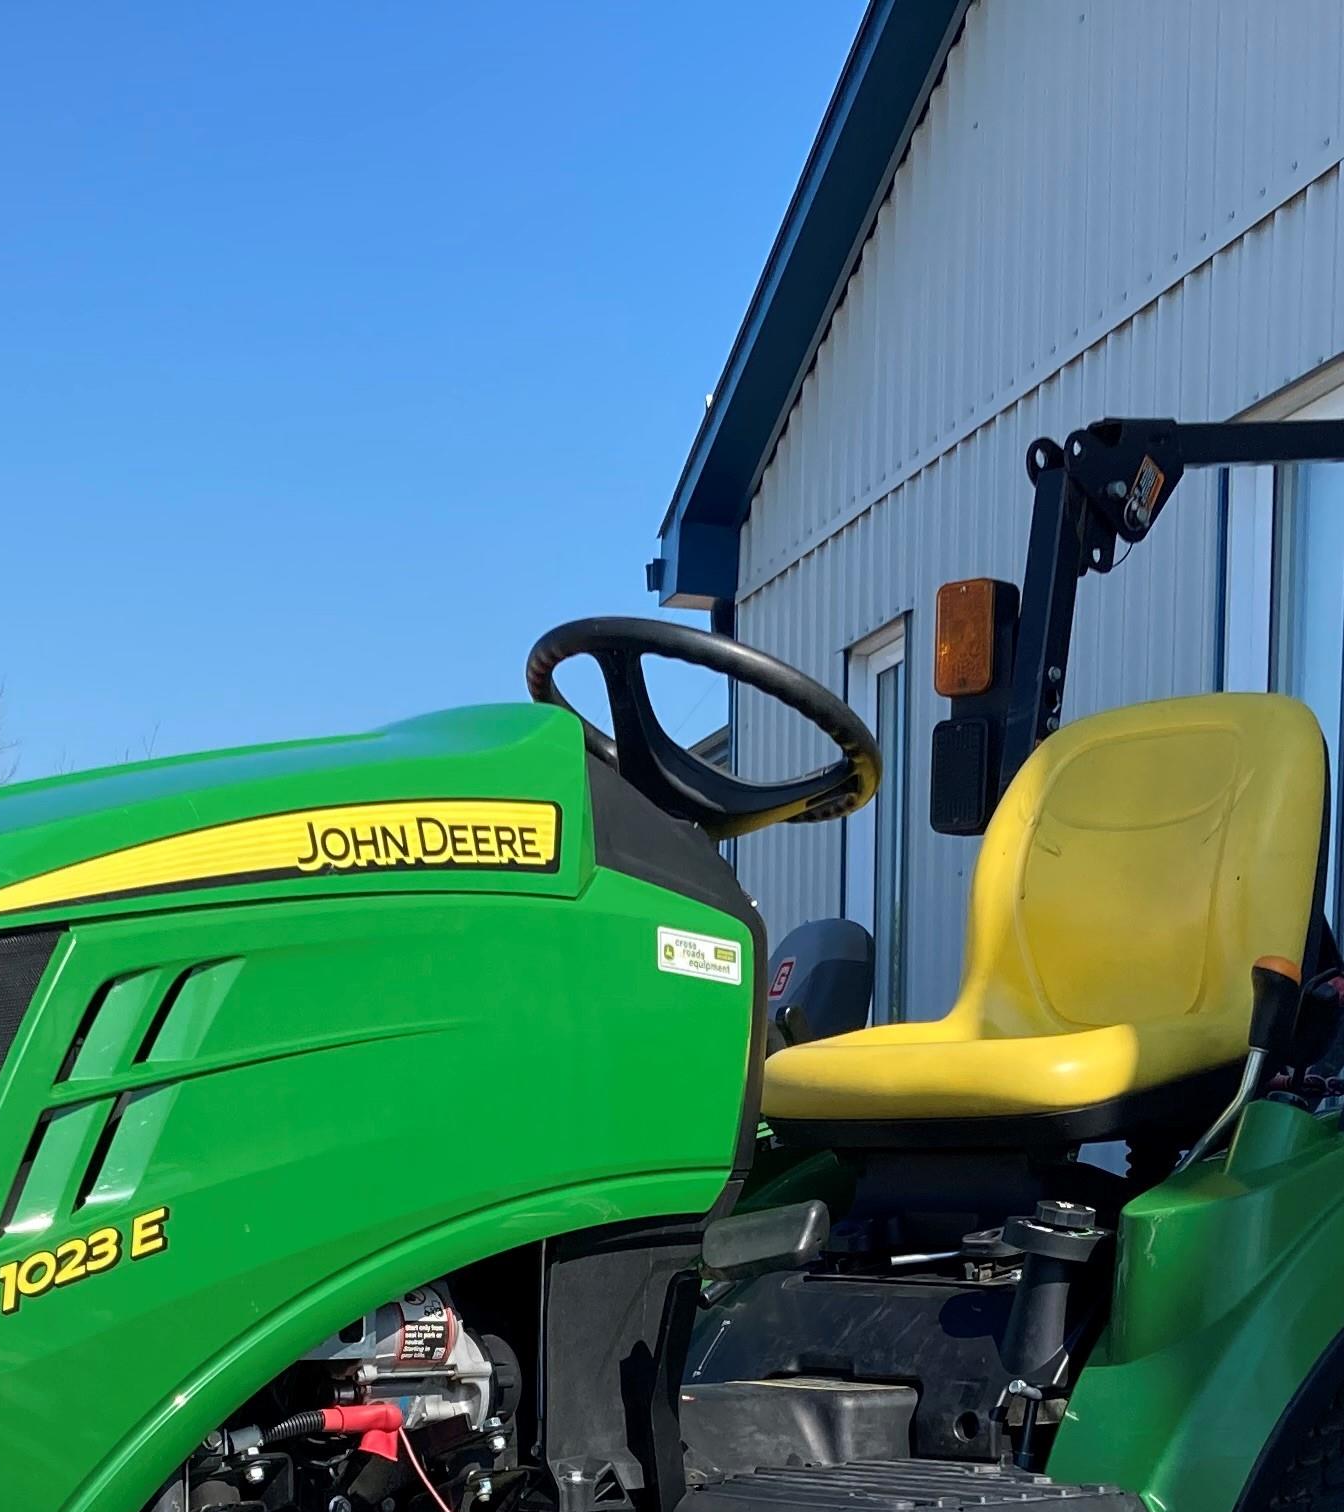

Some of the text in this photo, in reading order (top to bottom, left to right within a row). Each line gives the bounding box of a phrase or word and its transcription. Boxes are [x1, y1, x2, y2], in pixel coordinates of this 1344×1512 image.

[297, 817, 542, 865] JOHN DEERE
[688, 959, 730, 974] equipment
[0, 1207, 170, 1314] 1023 E
